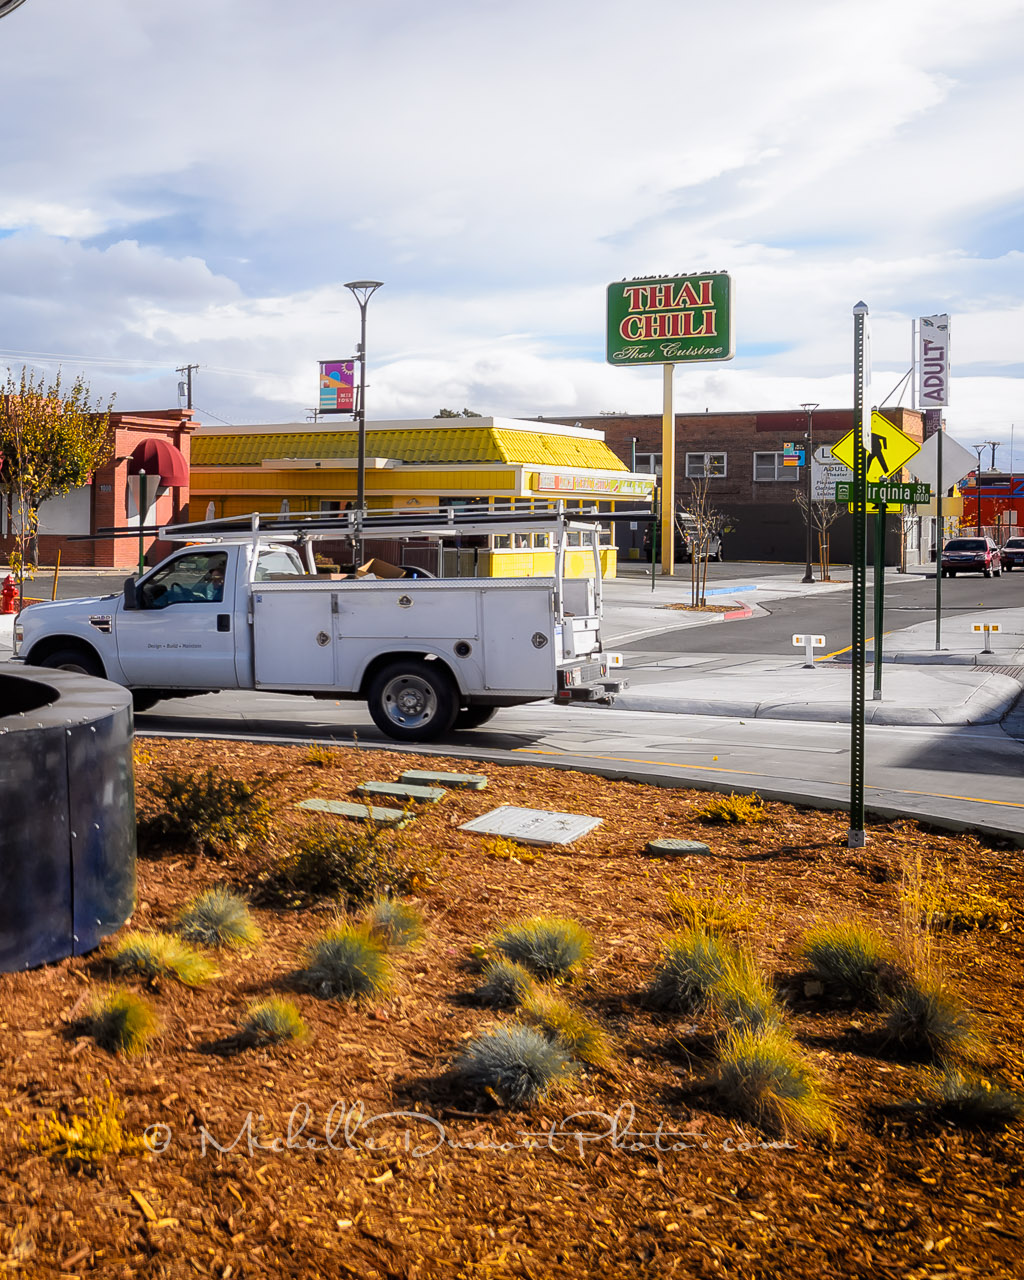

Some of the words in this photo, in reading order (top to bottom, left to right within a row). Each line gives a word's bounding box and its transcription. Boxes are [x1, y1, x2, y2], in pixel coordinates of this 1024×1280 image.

[623, 280, 714, 312] THAI
[619, 309, 717, 341] CHILI
[613, 345, 655, 360] Thai
[660, 342, 723, 358] Cuisine
[923, 340, 945, 402] ADULT
[867, 483, 911, 503] irginia
[917, 485, 926, 494] St
[913, 493, 929, 502] 1000
